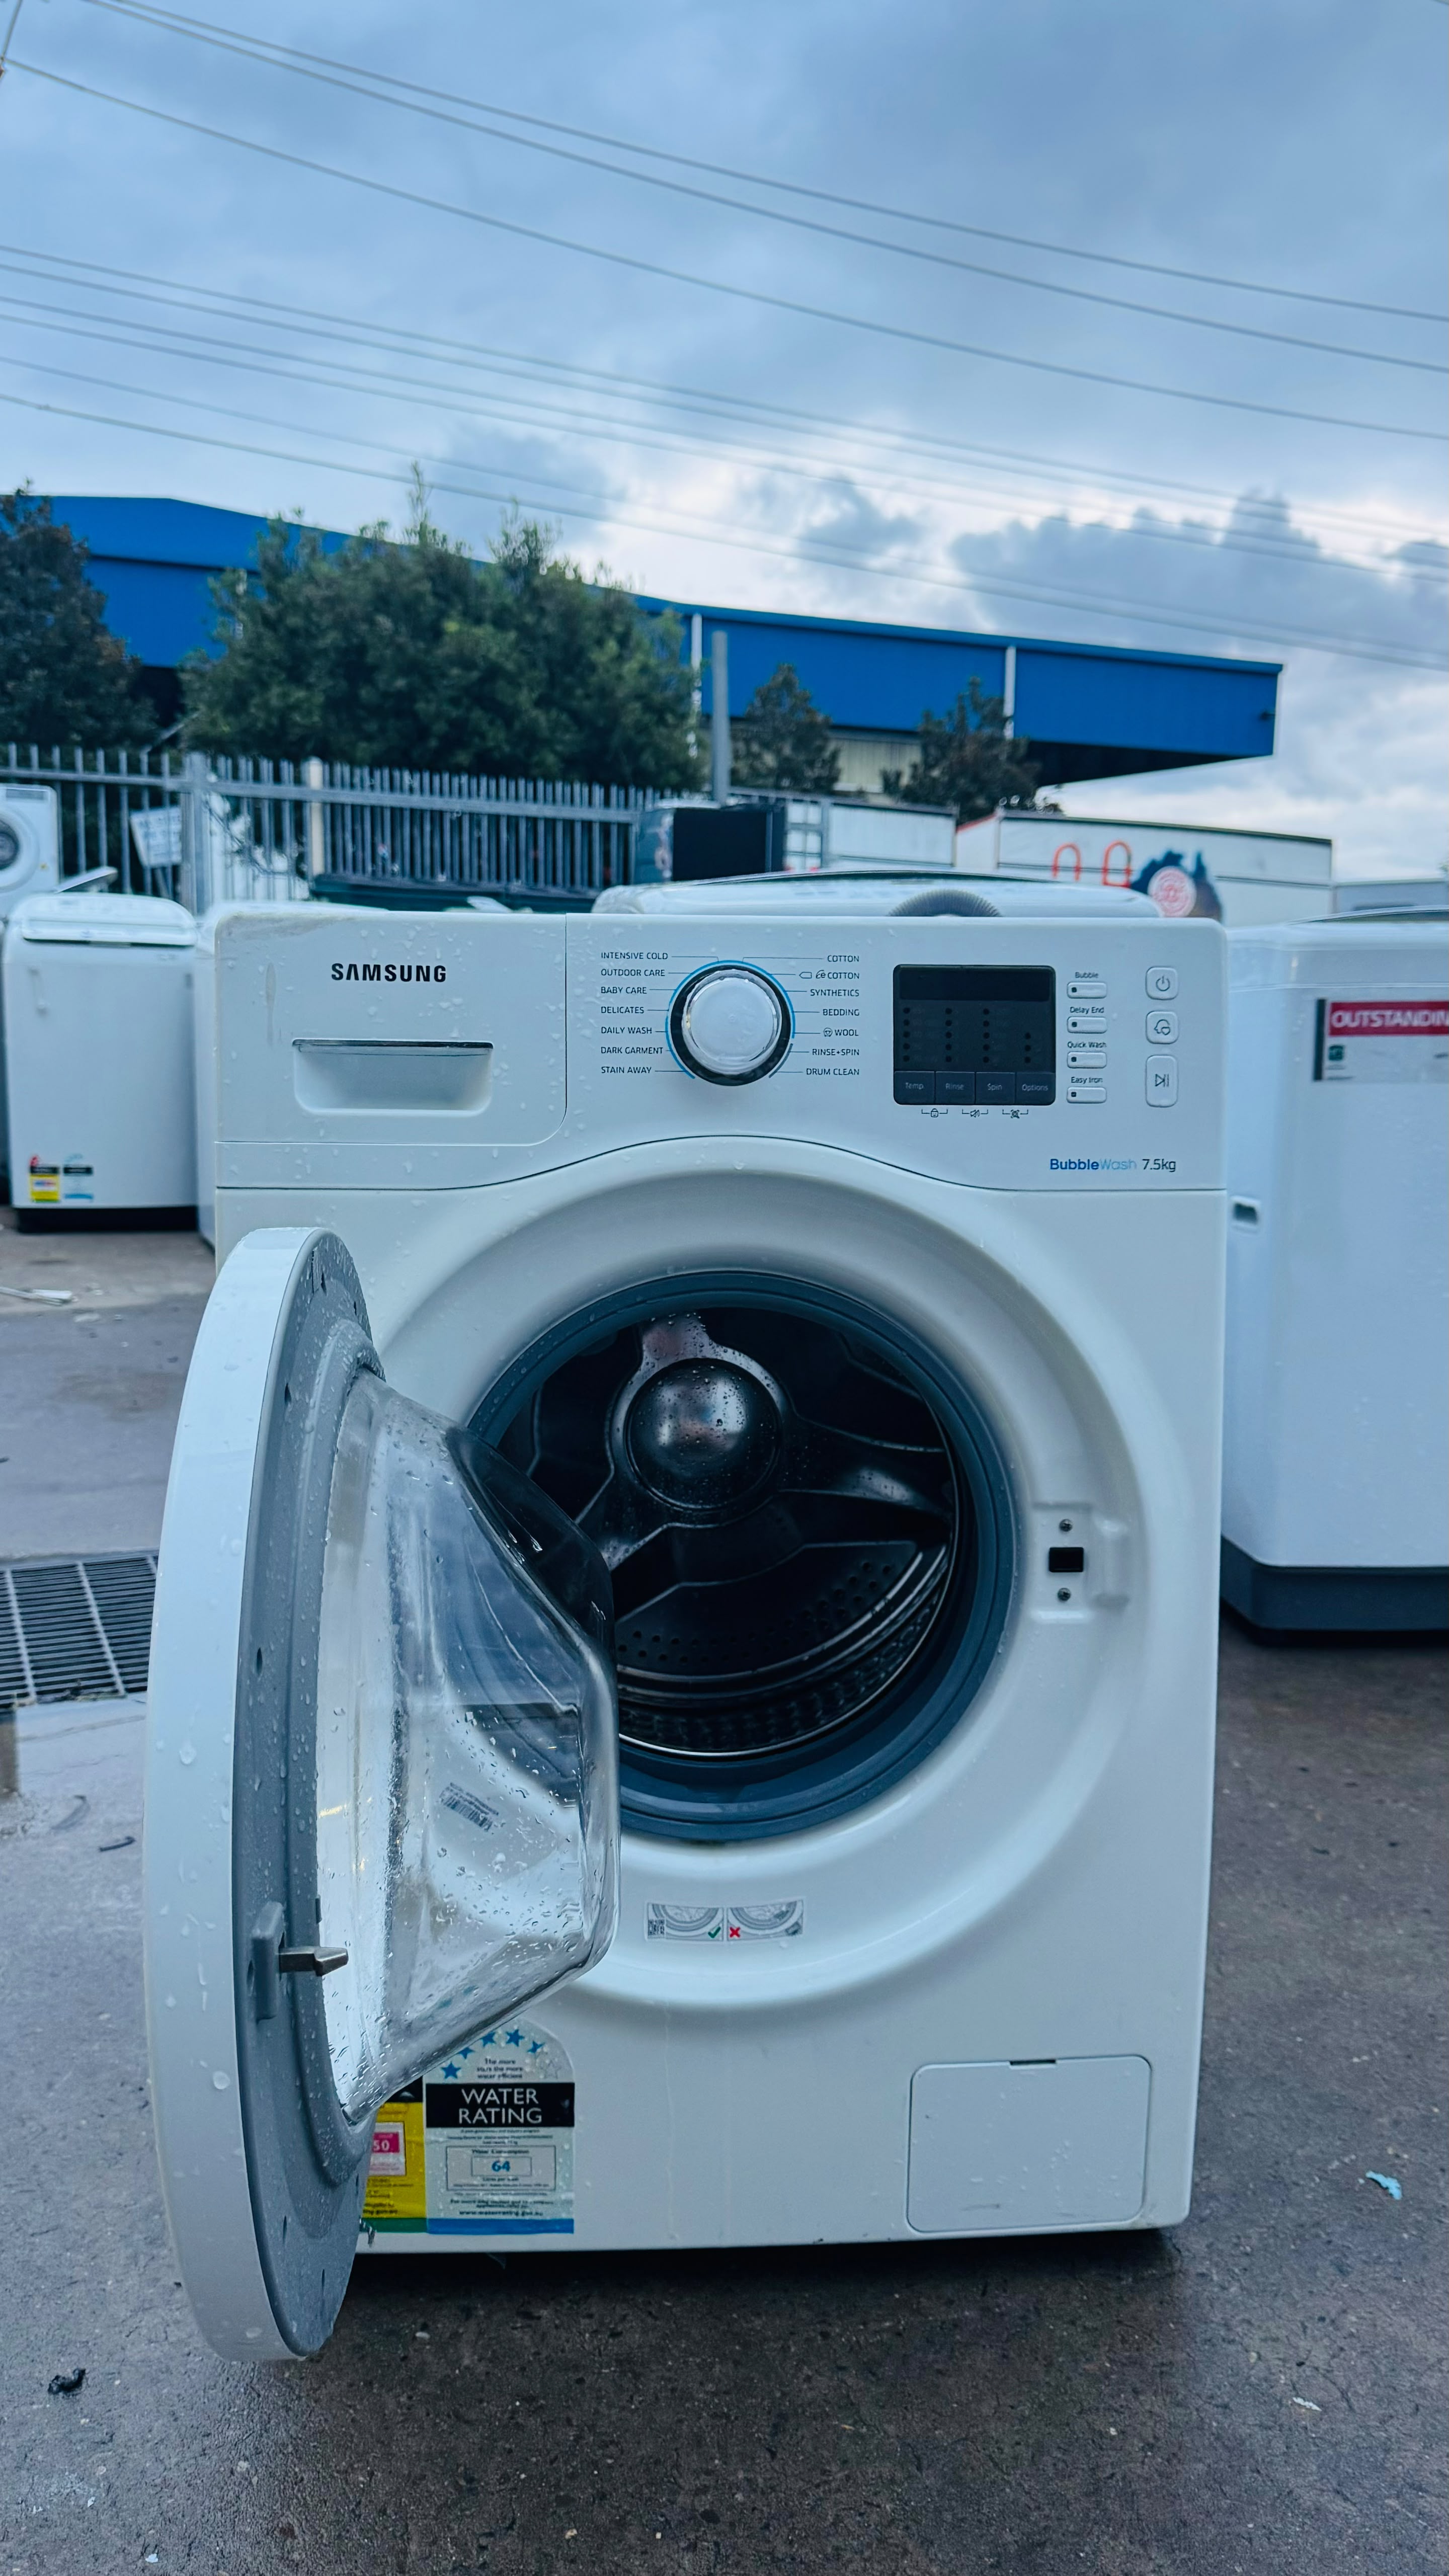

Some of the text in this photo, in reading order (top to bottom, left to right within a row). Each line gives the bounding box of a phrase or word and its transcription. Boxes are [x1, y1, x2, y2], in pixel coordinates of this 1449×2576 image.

[601, 951, 668, 960] INTENSIVE COLD
[331, 962, 447, 983] SAMSUNG
[601, 968, 666, 977] OUTDOOR CARE
[827, 972, 860, 980] COTTON
[601, 986, 648, 995] BABY CARE
[810, 989, 860, 997] SYNTHETICS
[823, 1008, 860, 1016] BEDDING
[1070, 1006, 1090, 1015] Delay
[627, 1026, 653, 1034] WASH
[601, 1046, 664, 1055] DARK GARMENT
[627, 1066, 652, 1074] AWAY
[1071, 1076, 1088, 1084] Easy
[905, 1082, 924, 1091] Temp
[987, 1083, 1003, 1091] Spin
[1021, 1083, 1049, 1091] Options
[1141, 1158, 1177, 1173] 7.5kg
[461, 2088, 539, 2105] WATER
[458, 2107, 542, 2124] RATING
[491, 2160, 511, 2172] 64
